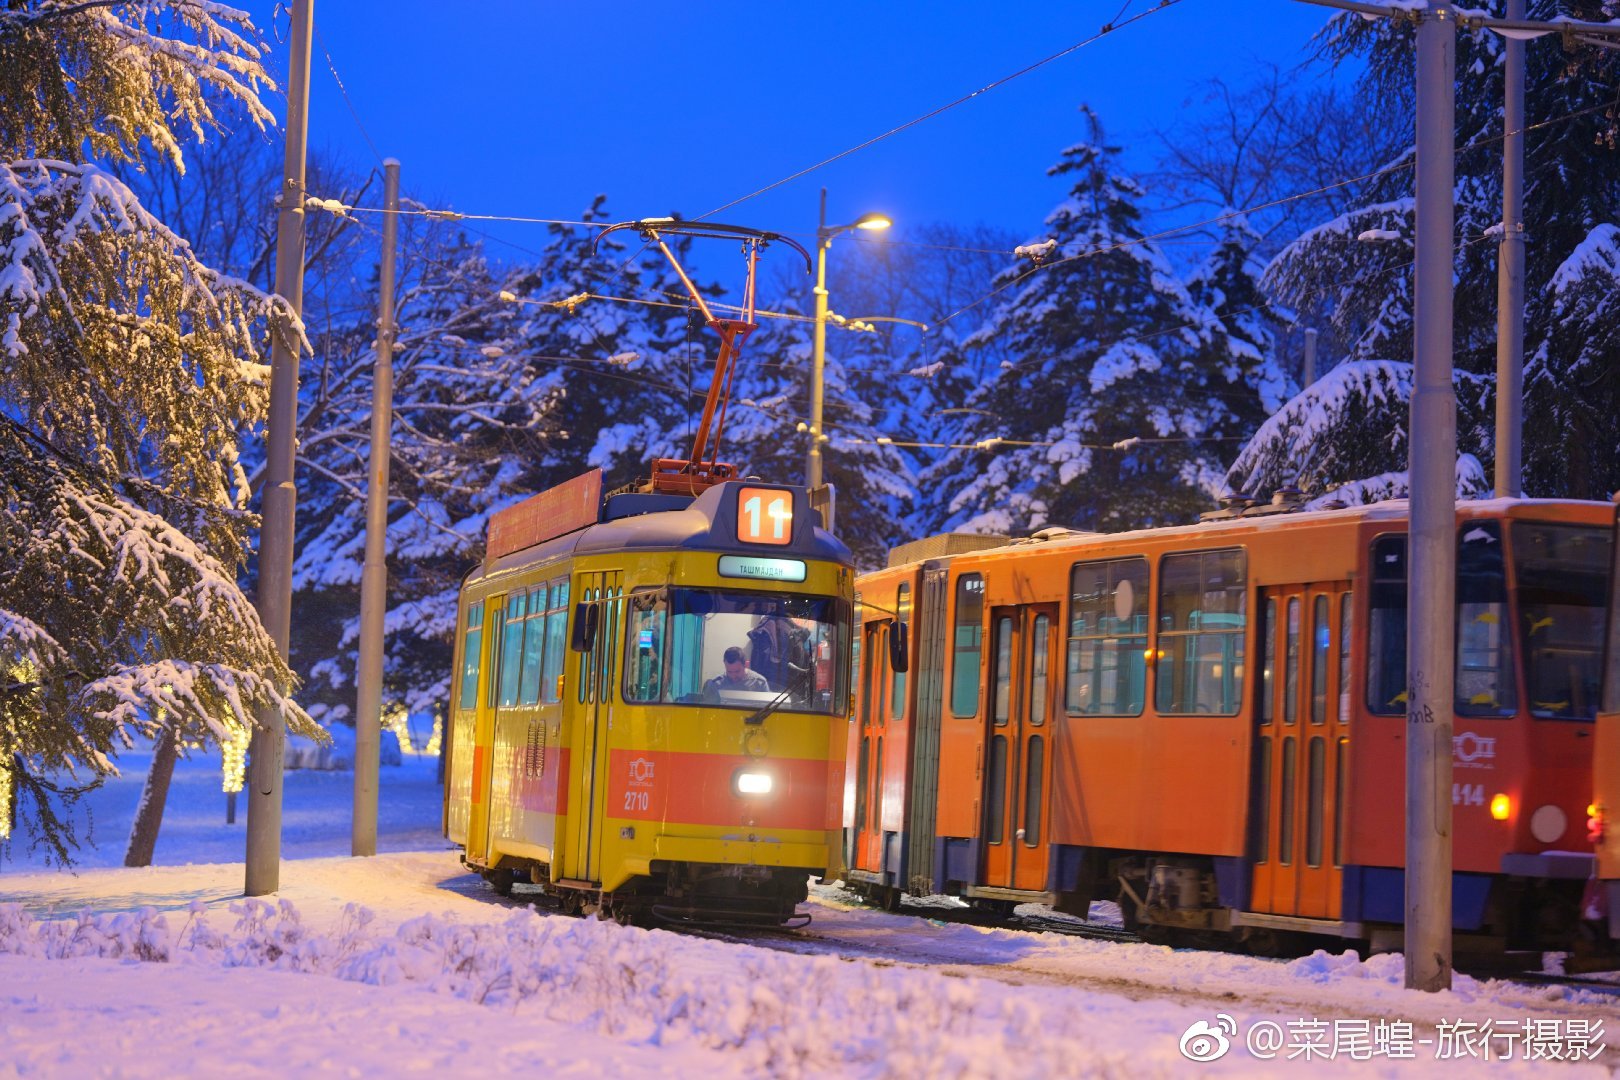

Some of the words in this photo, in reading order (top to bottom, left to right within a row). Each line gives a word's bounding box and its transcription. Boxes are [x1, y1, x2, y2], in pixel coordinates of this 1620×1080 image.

[744, 496, 784, 539] 11
[740, 565, 783, 577] ТАШМАЈДАН
[624, 791, 648, 811] 2710
